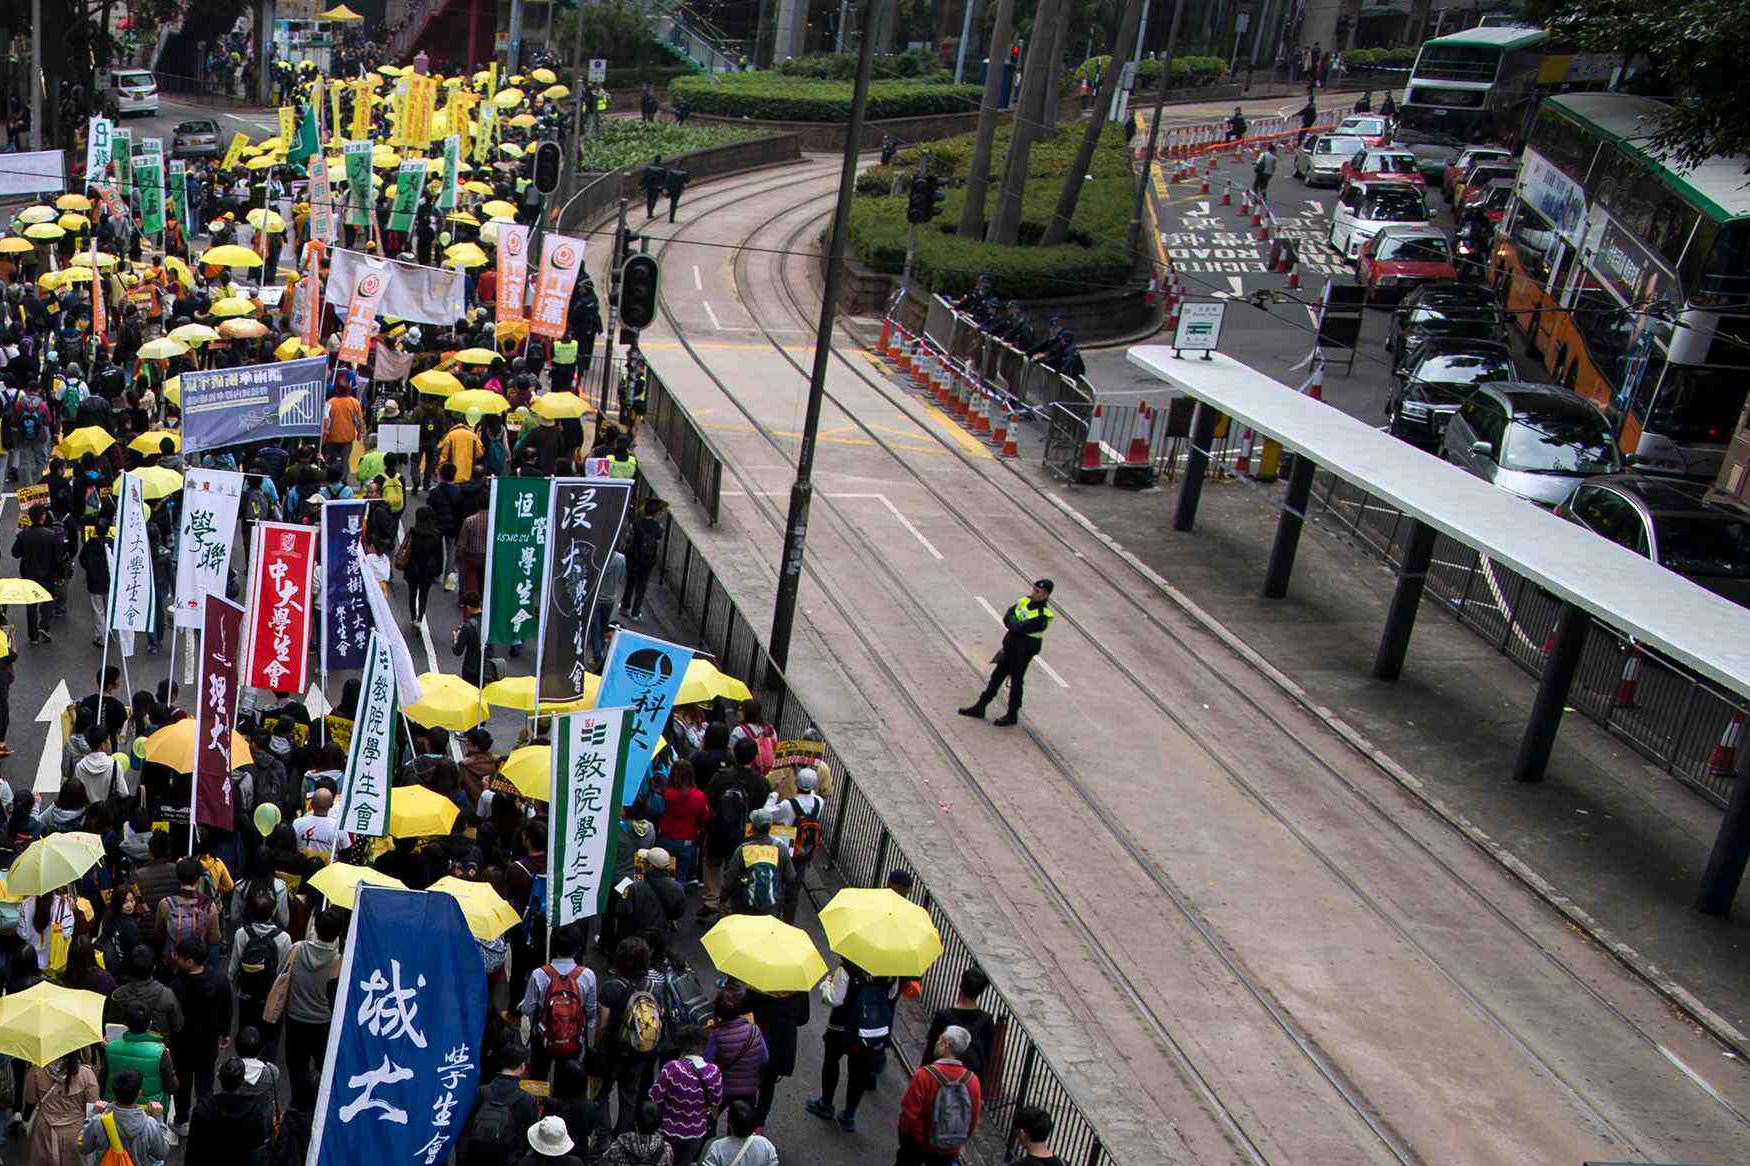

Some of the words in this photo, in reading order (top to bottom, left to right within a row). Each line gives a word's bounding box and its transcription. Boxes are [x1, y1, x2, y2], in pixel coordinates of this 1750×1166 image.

[184, 509, 226, 577] 學聯
[263, 558, 304, 689] 中大學生會
[338, 959, 427, 1125] 城大
[414, 1043, 475, 1166] 學生會
